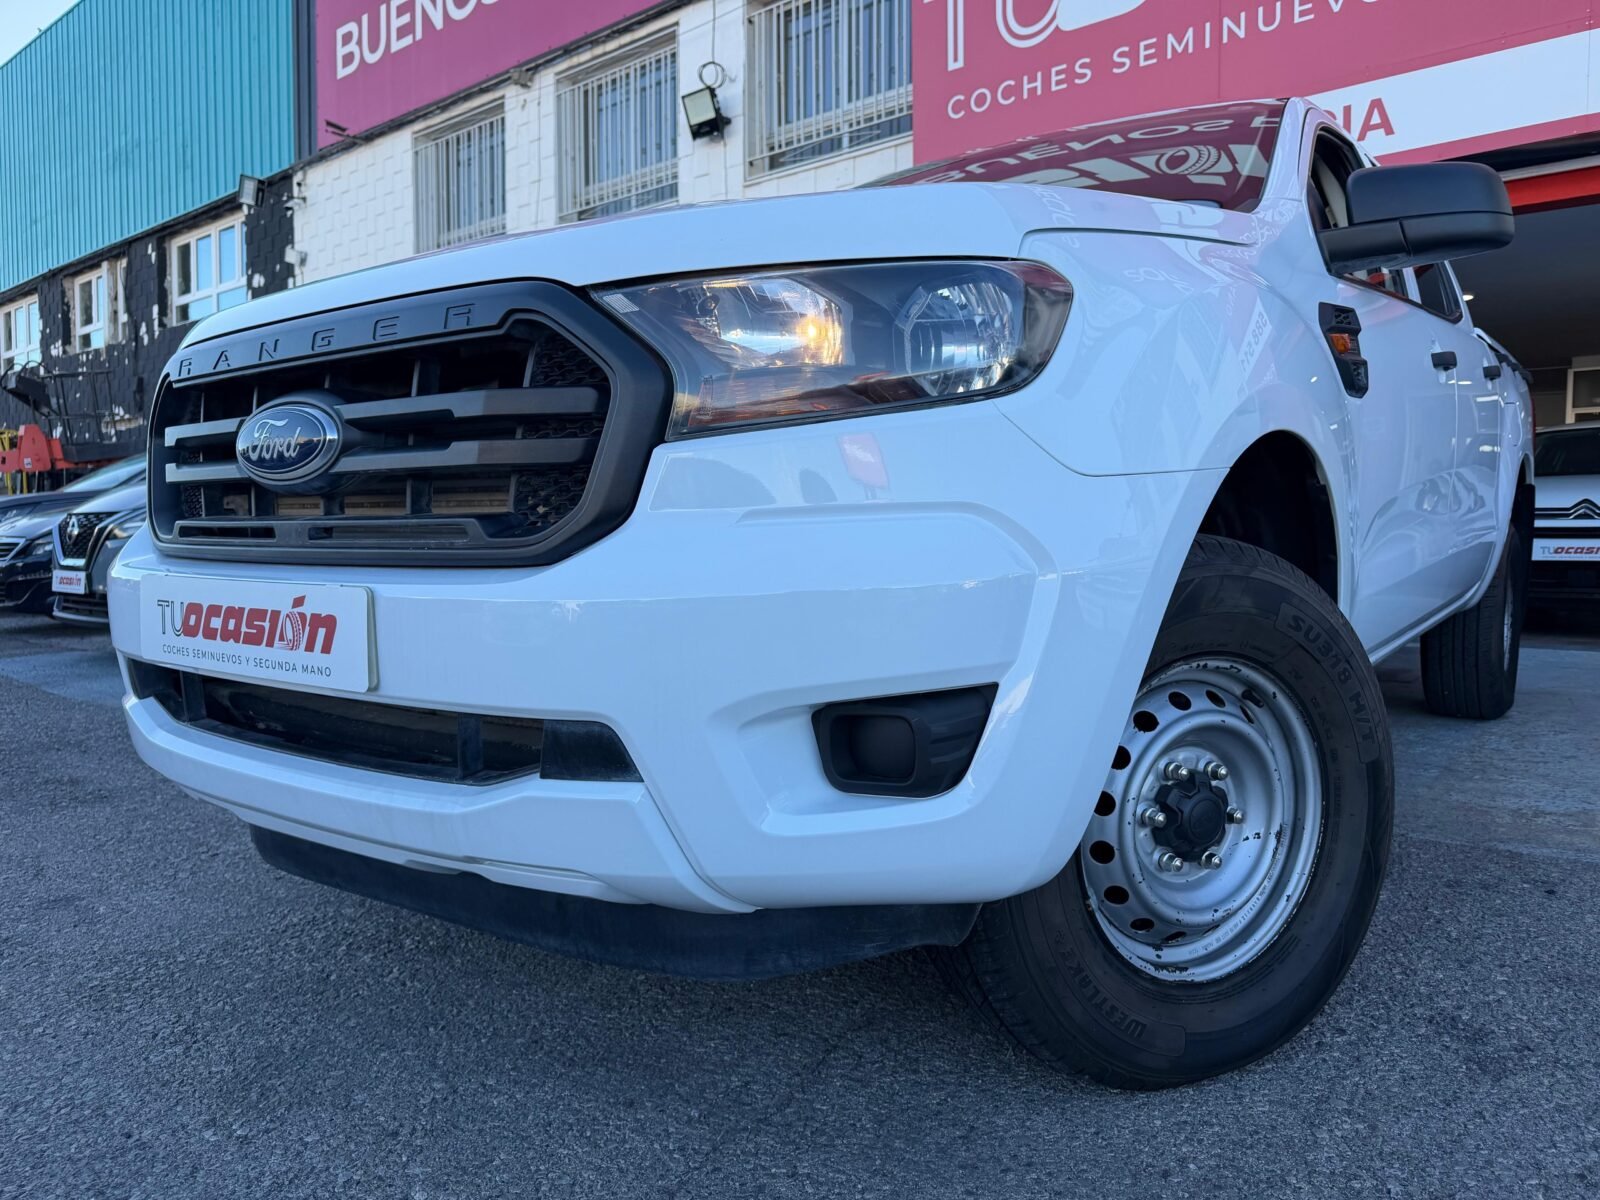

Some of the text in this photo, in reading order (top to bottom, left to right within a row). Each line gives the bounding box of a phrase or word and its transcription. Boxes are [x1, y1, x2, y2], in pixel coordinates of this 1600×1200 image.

[335, 0, 500, 80] BUEN
[947, 57, 1093, 119] COCHES
[178, 302, 476, 377] RANGER
[247, 418, 301, 461] Ford
[162, 643, 333, 678] COCHES SEMINUEVOS Y SEGUNDA MANO
[1287, 614, 1353, 684] SU318
